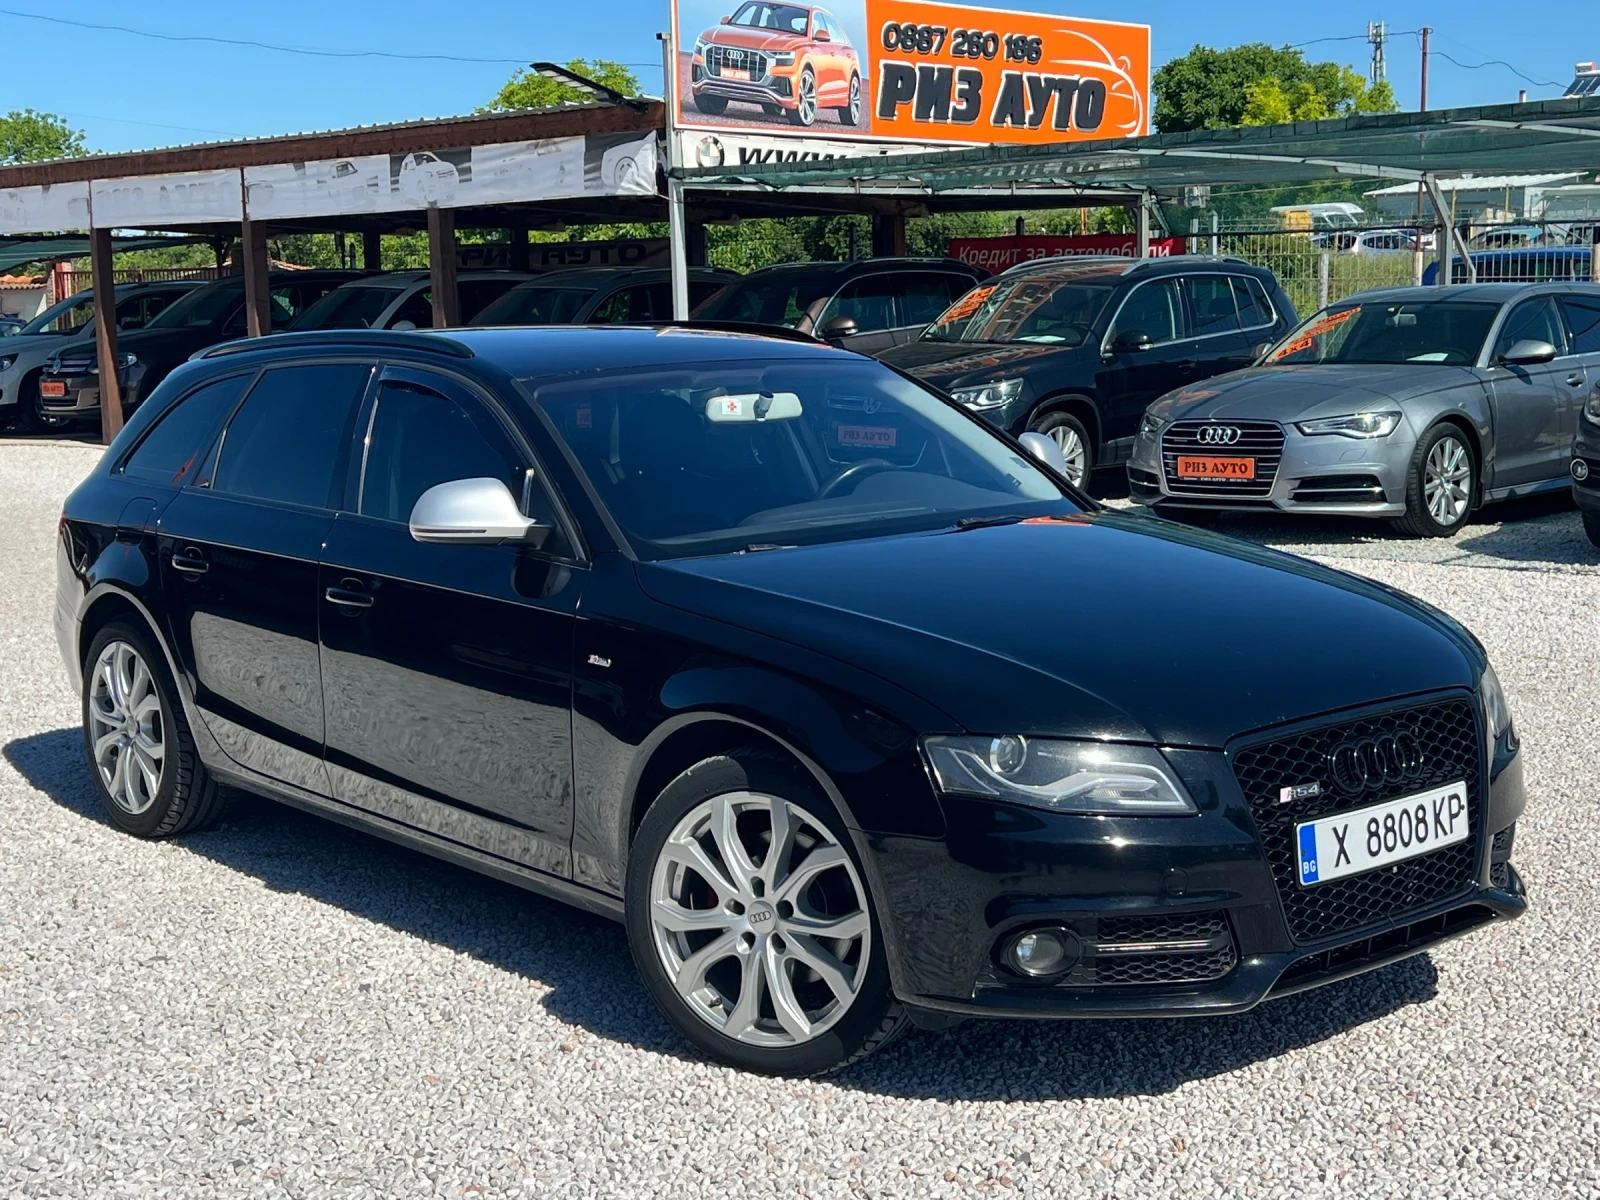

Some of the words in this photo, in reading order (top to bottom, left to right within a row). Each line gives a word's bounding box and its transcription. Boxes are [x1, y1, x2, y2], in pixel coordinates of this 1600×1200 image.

[882, 20, 948, 55] 0887
[950, 28, 999, 60] 260
[1003, 32, 1043, 64] 186
[876, 59, 983, 125] РИЗ
[990, 70, 1107, 132] АУТО
[461, 248, 513, 267] РИ
[541, 244, 646, 266] АУТО
[959, 246, 1021, 268] Кредит
[1026, 247, 1046, 260] за
[1053, 241, 1170, 258] автомобли
[1184, 461, 1207, 473] РИЗ
[1211, 462, 1248, 474] АУТО
[1331, 824, 1351, 868] X
[1302, 861, 1317, 875] BG
